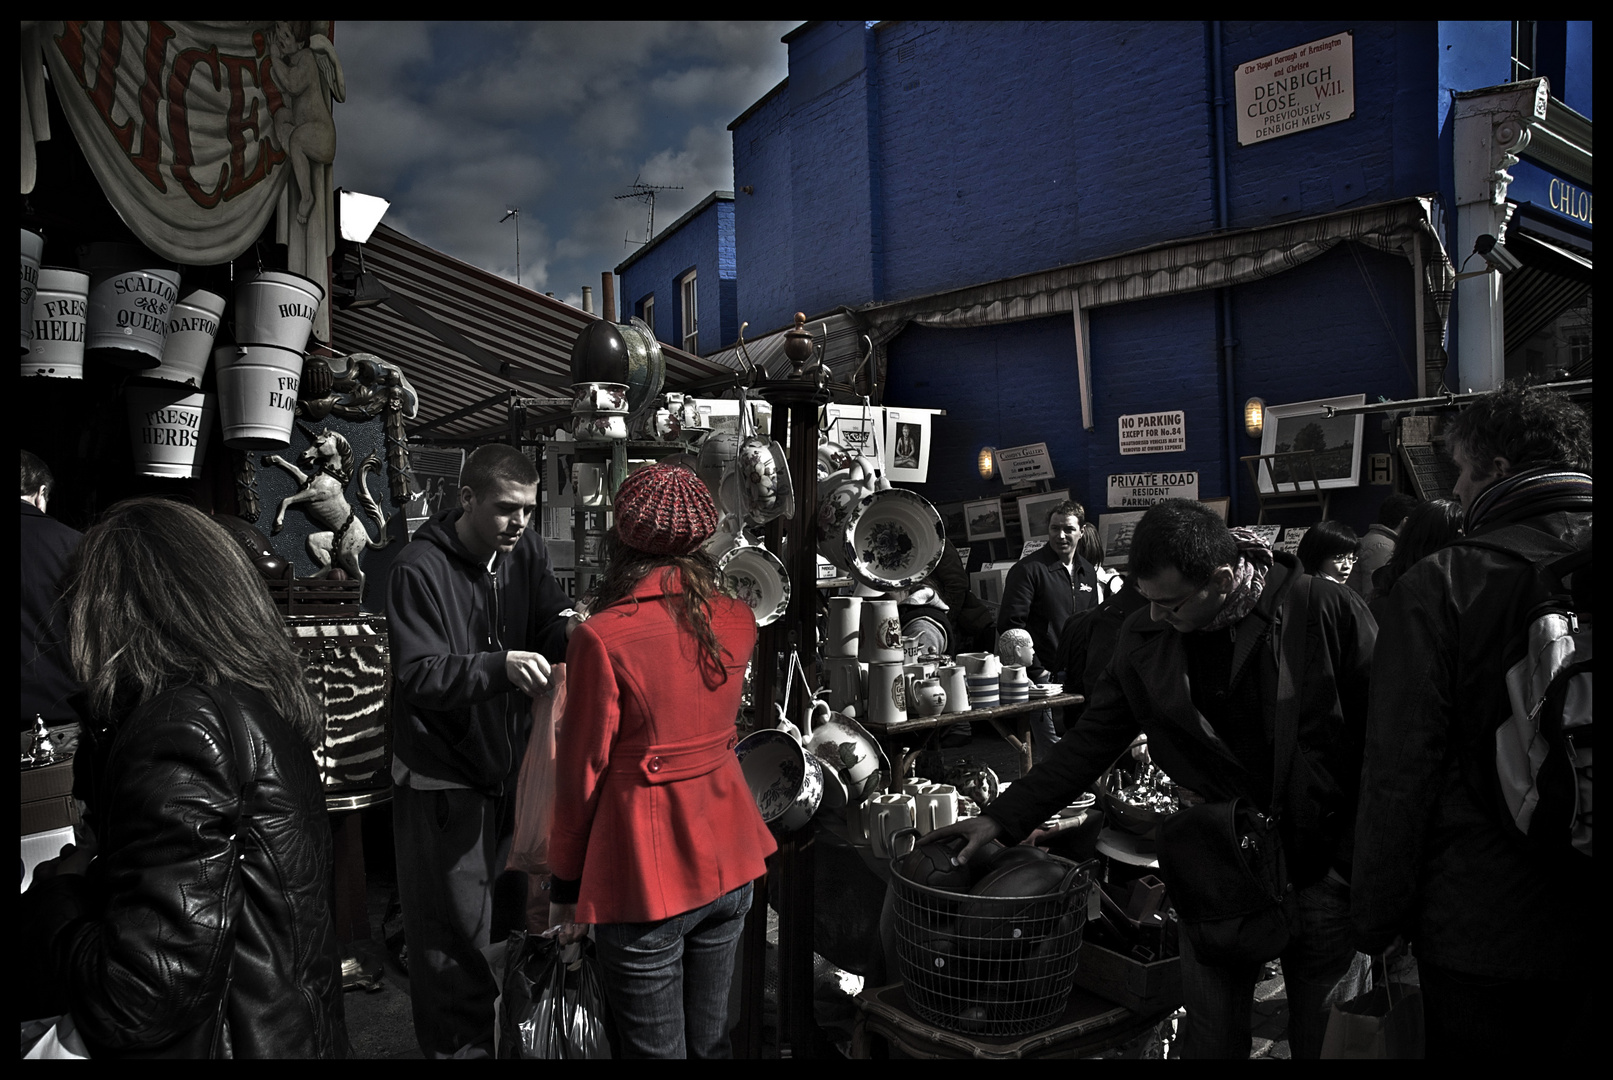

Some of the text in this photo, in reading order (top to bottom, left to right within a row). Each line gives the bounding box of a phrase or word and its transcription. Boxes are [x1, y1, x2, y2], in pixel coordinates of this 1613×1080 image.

[1245, 39, 1341, 74] The Royal Borough of Kensington
[1274, 61, 1309, 77] and Chelsea
[1255, 66, 1332, 100] DENBIGH
[54, 21, 287, 209] LICE'S
[1264, 103, 1321, 125] PREVIOUSLY
[1256, 111, 1331, 138] DENBIGH MEWS
[144, 409, 199, 428] FRESH
[1122, 414, 1181, 429] NO PARKING
[142, 427, 200, 447] HERBS
[1122, 427, 1181, 438] EXCEPT FOR No.84
[1111, 473, 1194, 487] PRIVATE ROAD
[1132, 487, 1169, 496] RESIDENT
[1122, 497, 1156, 506] PARKING
